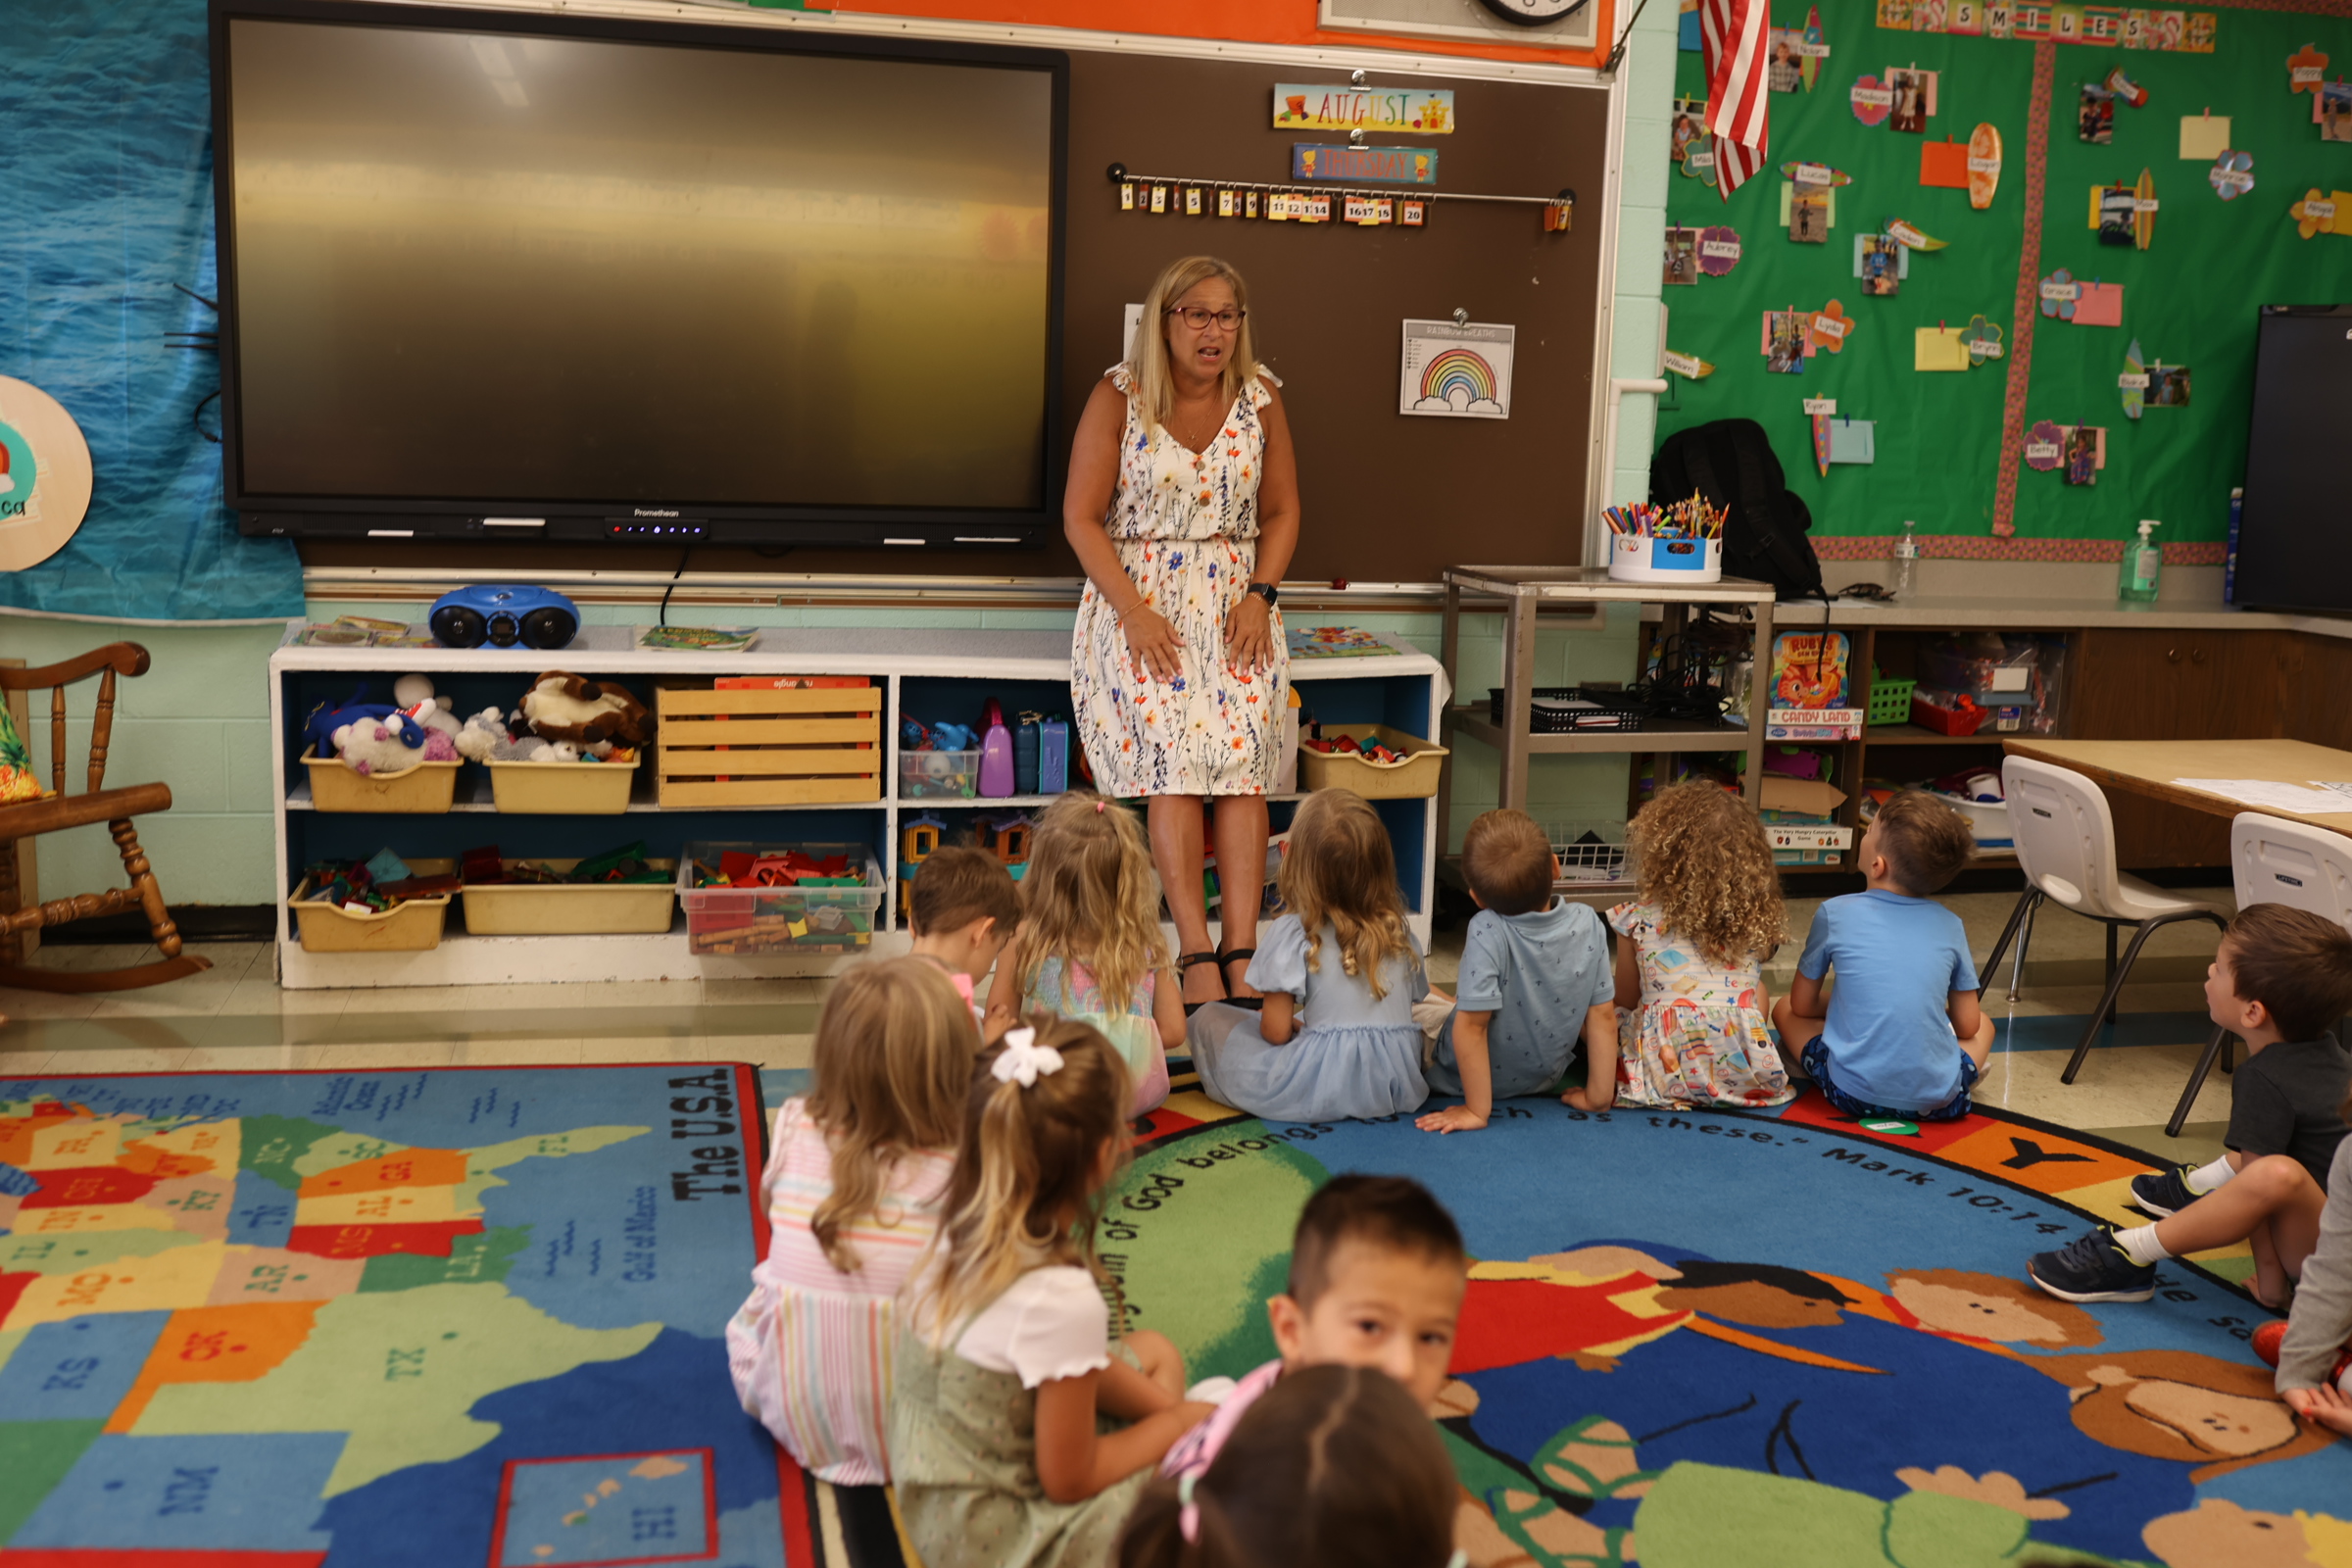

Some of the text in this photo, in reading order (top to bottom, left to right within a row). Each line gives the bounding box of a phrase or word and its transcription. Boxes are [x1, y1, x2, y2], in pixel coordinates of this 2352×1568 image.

[1317, 92, 1410, 125] AUGUST
[1323, 148, 1408, 178] THURSDAY
[1800, 170, 1829, 181] Lucas
[1190, 197, 1198, 207] 5
[1223, 199, 1231, 209] 7
[1249, 201, 1255, 210] 9
[1273, 203, 1285, 212] 11
[1288, 204, 1299, 213] 12
[1314, 206, 1327, 215] 14
[1348, 207, 1362, 216] 16
[1363, 207, 1375, 217] 17
[1378, 208, 1390, 219] 18
[1407, 211, 1420, 220] 20
[1665, 355, 1694, 373] William
[1805, 401, 1827, 413] Ryan
[2030, 446, 2057, 458] Betty
[633, 508, 680, 518] Promethean
[773, 678, 814, 690] reangle
[1781, 711, 1851, 724] CANDY LAND
[1567, 1109, 1613, 1124] as
[1174, 1120, 1335, 1171] belongs
[379, 1160, 414, 1182] GA
[670, 1145, 742, 1201] The
[1821, 1146, 1936, 1187] Mark
[1121, 1173, 1185, 1212] God
[1946, 1185, 2069, 1236] 10:14
[1102, 1216, 1142, 1242] of
[243, 1264, 290, 1294] AR
[56, 1272, 113, 1307] MO
[385, 1348, 426, 1382] TX
[40, 1356, 101, 1392] KS
[157, 1466, 220, 1517] NM
